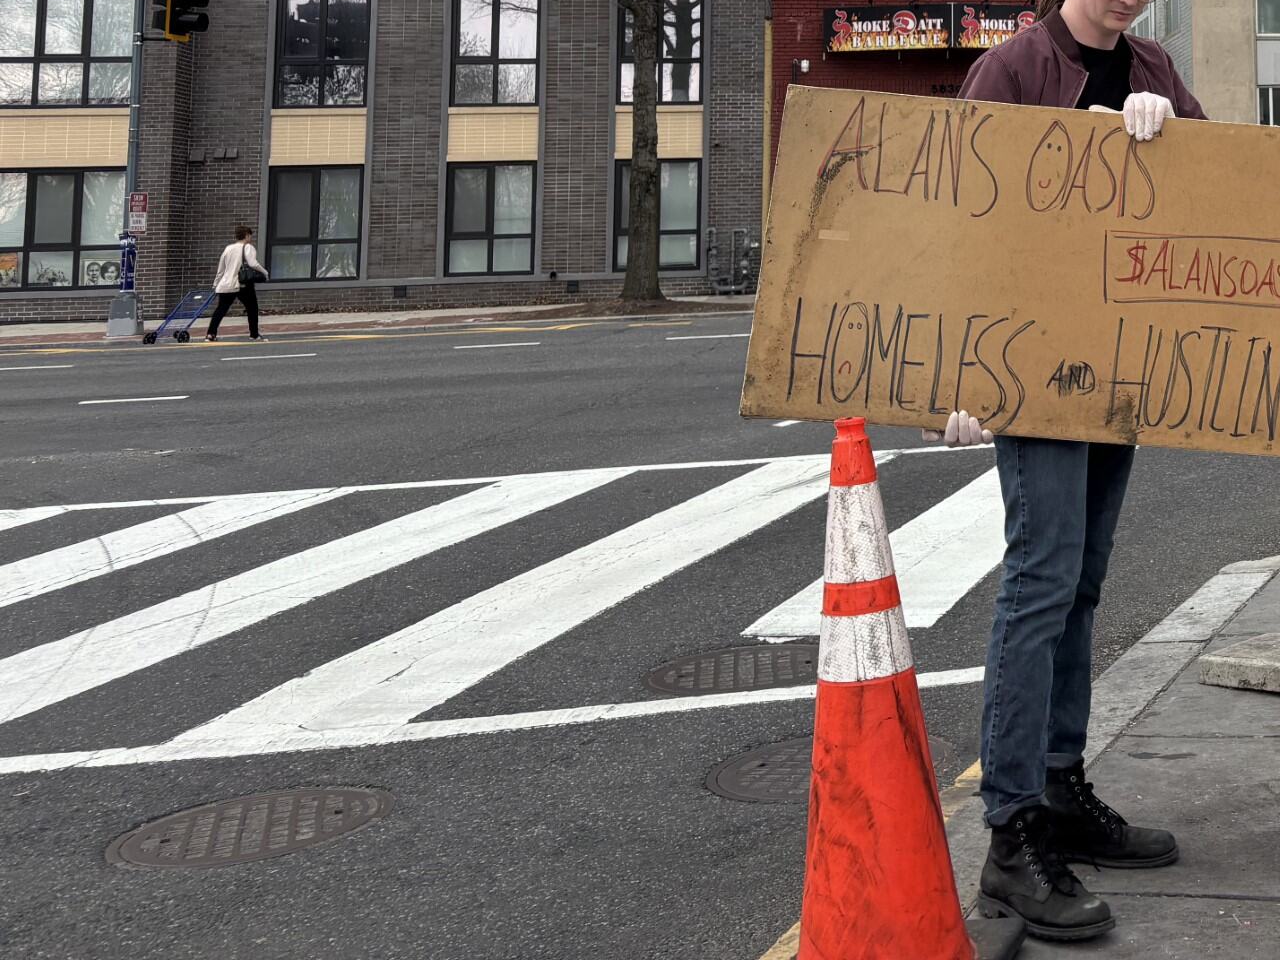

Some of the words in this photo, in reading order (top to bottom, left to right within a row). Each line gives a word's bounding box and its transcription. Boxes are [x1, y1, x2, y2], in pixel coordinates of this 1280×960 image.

[817, 95, 999, 218] ALAN'S
[1025, 118, 1163, 221] OASIS
[786, 296, 1037, 434] HOMELESS
[1046, 358, 1097, 398] AND
